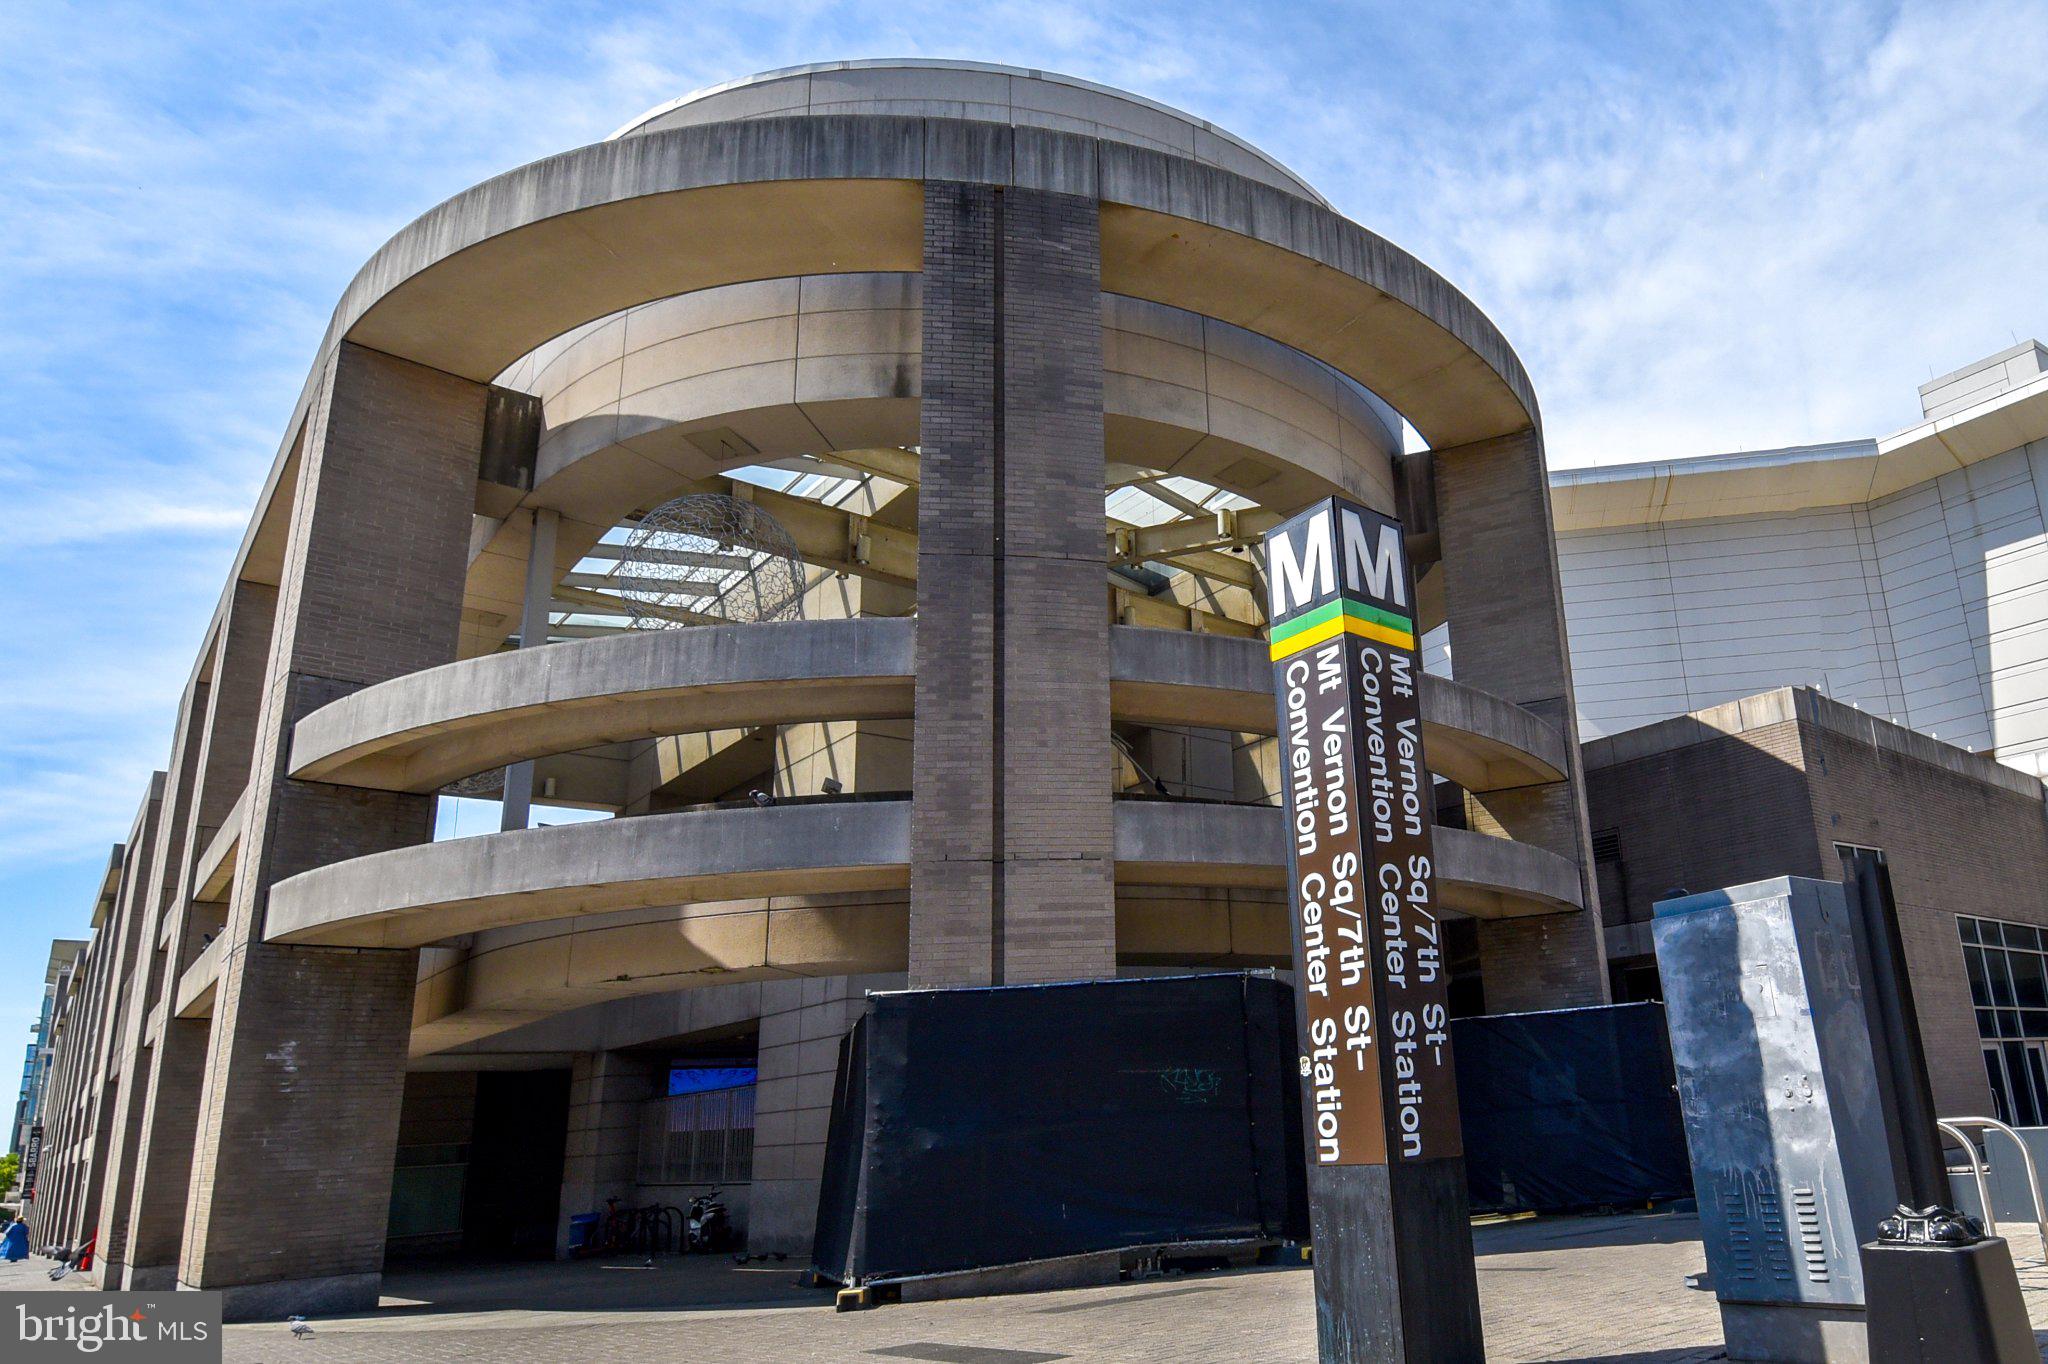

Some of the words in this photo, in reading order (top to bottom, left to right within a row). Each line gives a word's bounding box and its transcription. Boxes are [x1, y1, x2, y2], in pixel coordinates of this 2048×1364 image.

[1269, 509, 1336, 617] M
[1340, 507, 1407, 608] M
[1316, 644, 1342, 695] Mt
[1389, 653, 1412, 699] Mt
[1286, 660, 1319, 856] Convention
[1322, 707, 1349, 836] Vernon
[1360, 647, 1395, 843] Convention
[1395, 718, 1421, 836] Vernon
[1301, 872, 1330, 998] Center
[1329, 851, 1366, 987] Sq/7th
[1378, 862, 1408, 990] Center
[1406, 854, 1439, 984] Sq/7th
[1311, 1017, 1342, 1163] Station
[1391, 1010, 1423, 1158] Station
[28, 1136, 40, 1168] SBARRO
